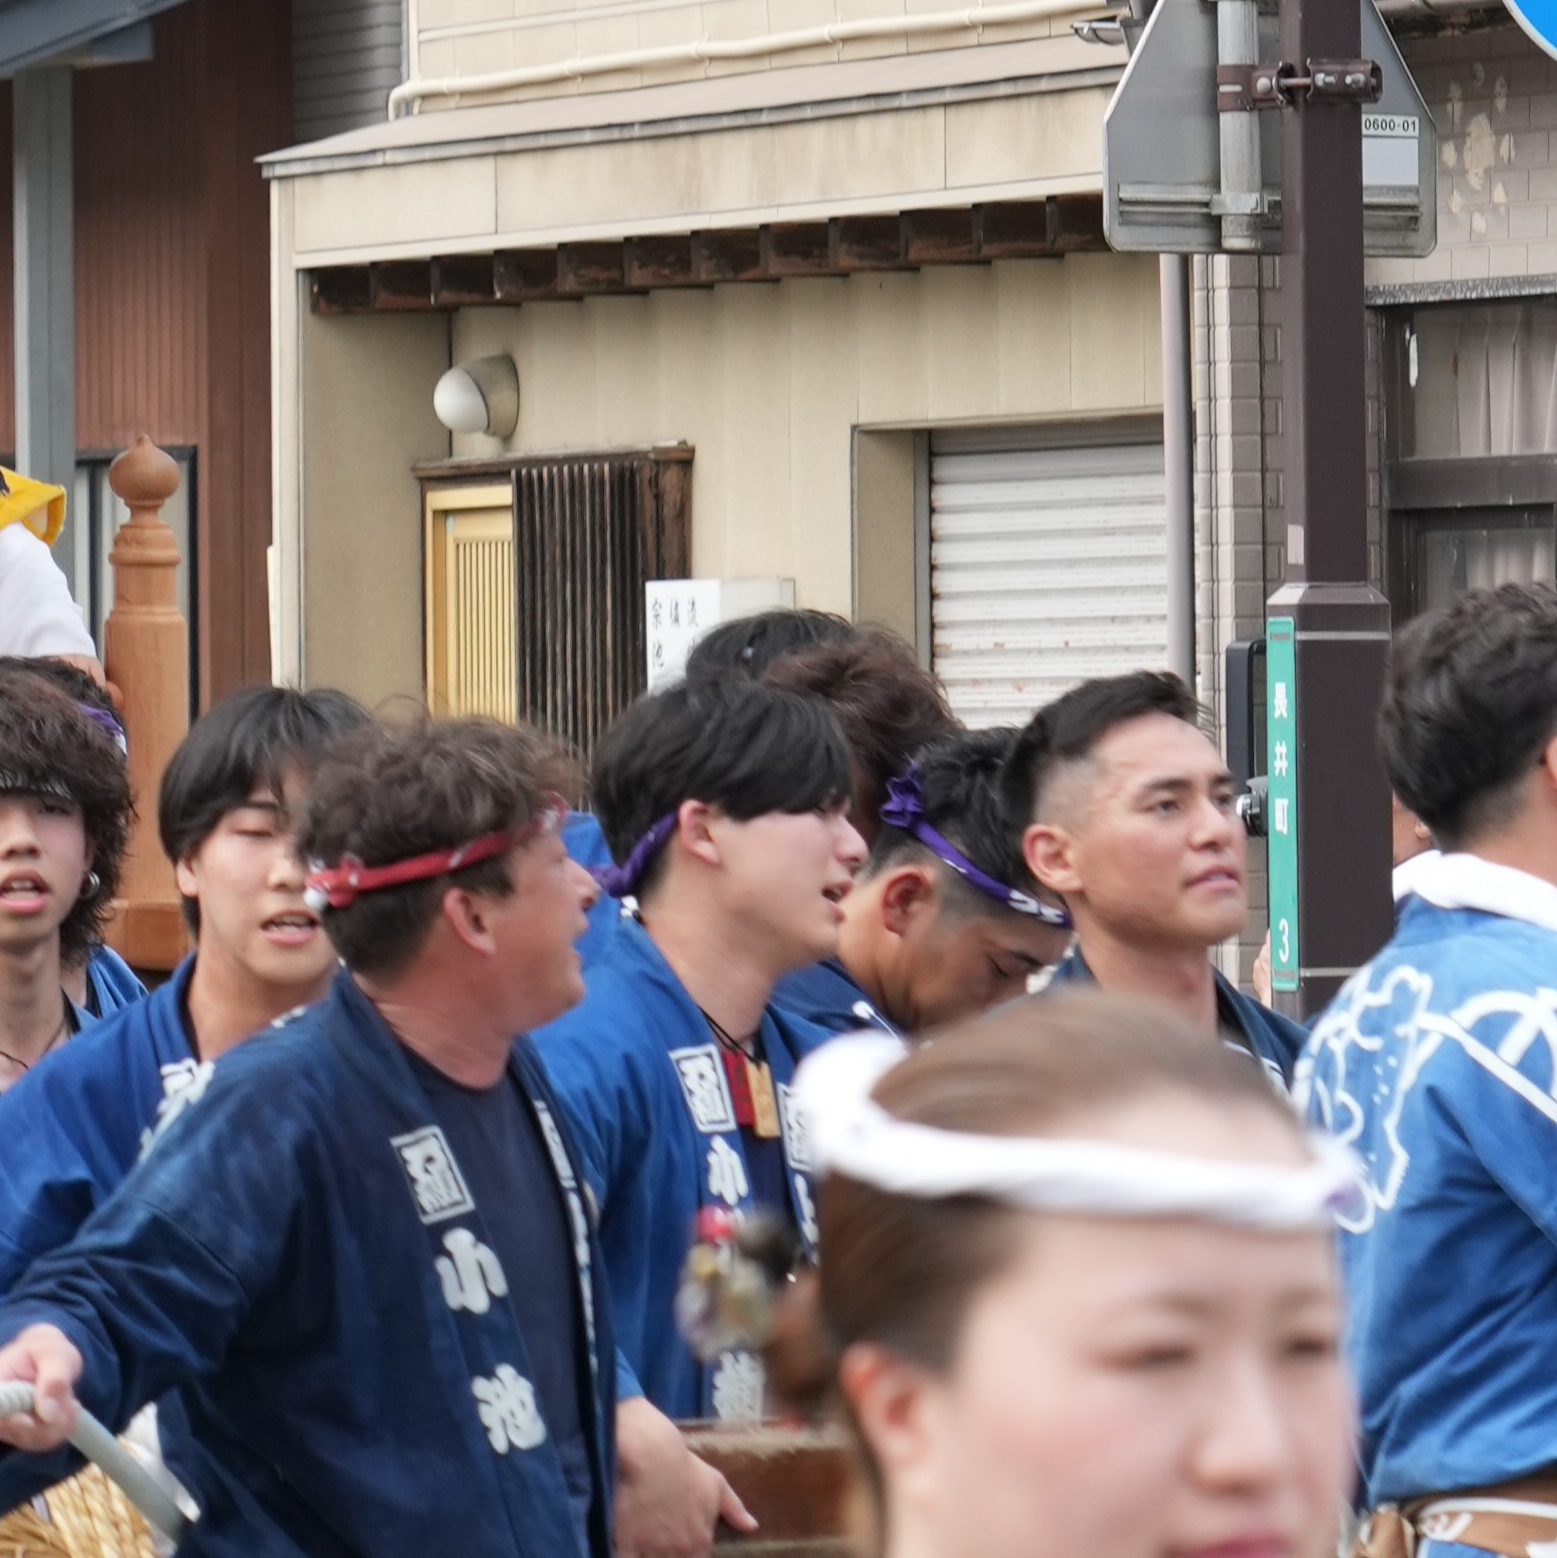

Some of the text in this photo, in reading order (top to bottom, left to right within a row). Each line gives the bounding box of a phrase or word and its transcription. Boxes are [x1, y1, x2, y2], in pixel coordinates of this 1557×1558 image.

[1273, 682, 1290, 964] 長井町 3
